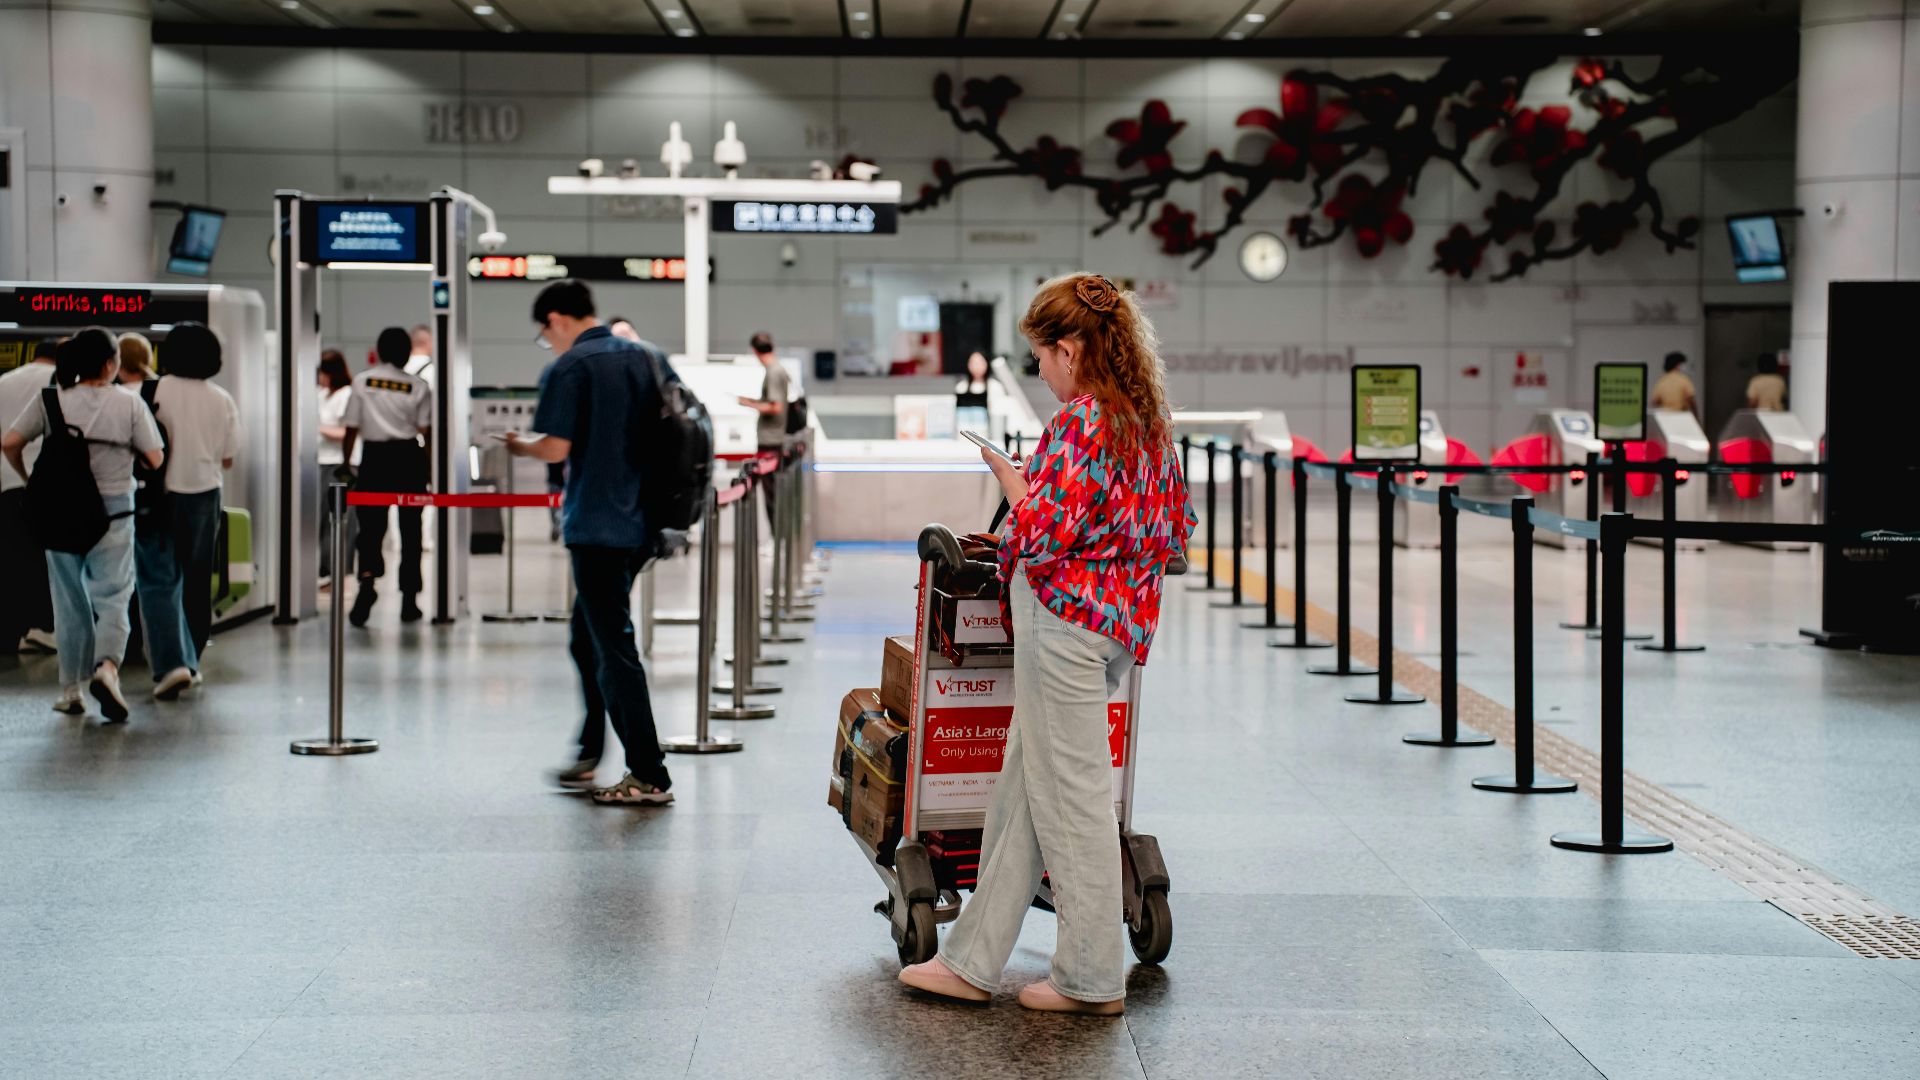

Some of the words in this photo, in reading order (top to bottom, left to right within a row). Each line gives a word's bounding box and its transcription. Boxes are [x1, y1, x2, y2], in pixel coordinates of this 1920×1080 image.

[424, 103, 522, 143] HELLO
[31, 293, 97, 315] drinks,
[1165, 345, 1355, 379] ozdravljen!
[933, 726, 972, 739] Asia's
[941, 748, 965, 759] Only
[969, 747, 998, 758] Using
